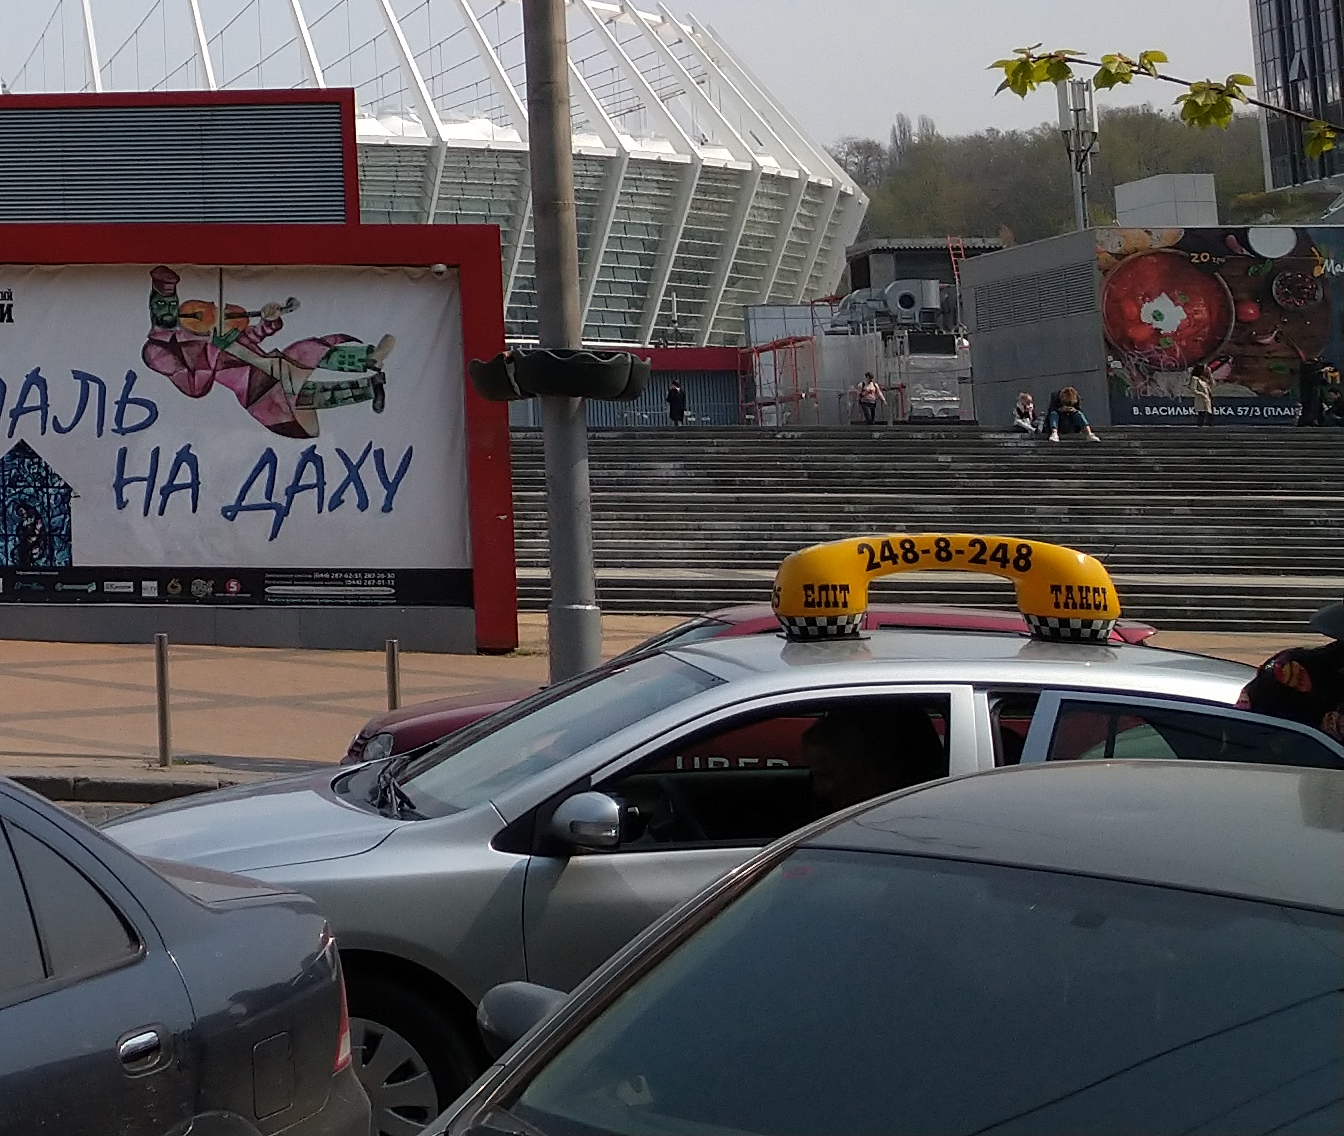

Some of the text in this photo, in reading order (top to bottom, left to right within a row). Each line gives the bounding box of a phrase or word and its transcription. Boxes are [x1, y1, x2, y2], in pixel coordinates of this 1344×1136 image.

[1190, 252, 1210, 263] 20
[1237, 407, 1261, 417] 57/3
[112, 441, 413, 541] НА ДАХУ
[857, 537, 1033, 572] 248-8-248
[803, 584, 849, 608] ЕЛІТ
[1050, 584, 1108, 611] ТАКСІ
